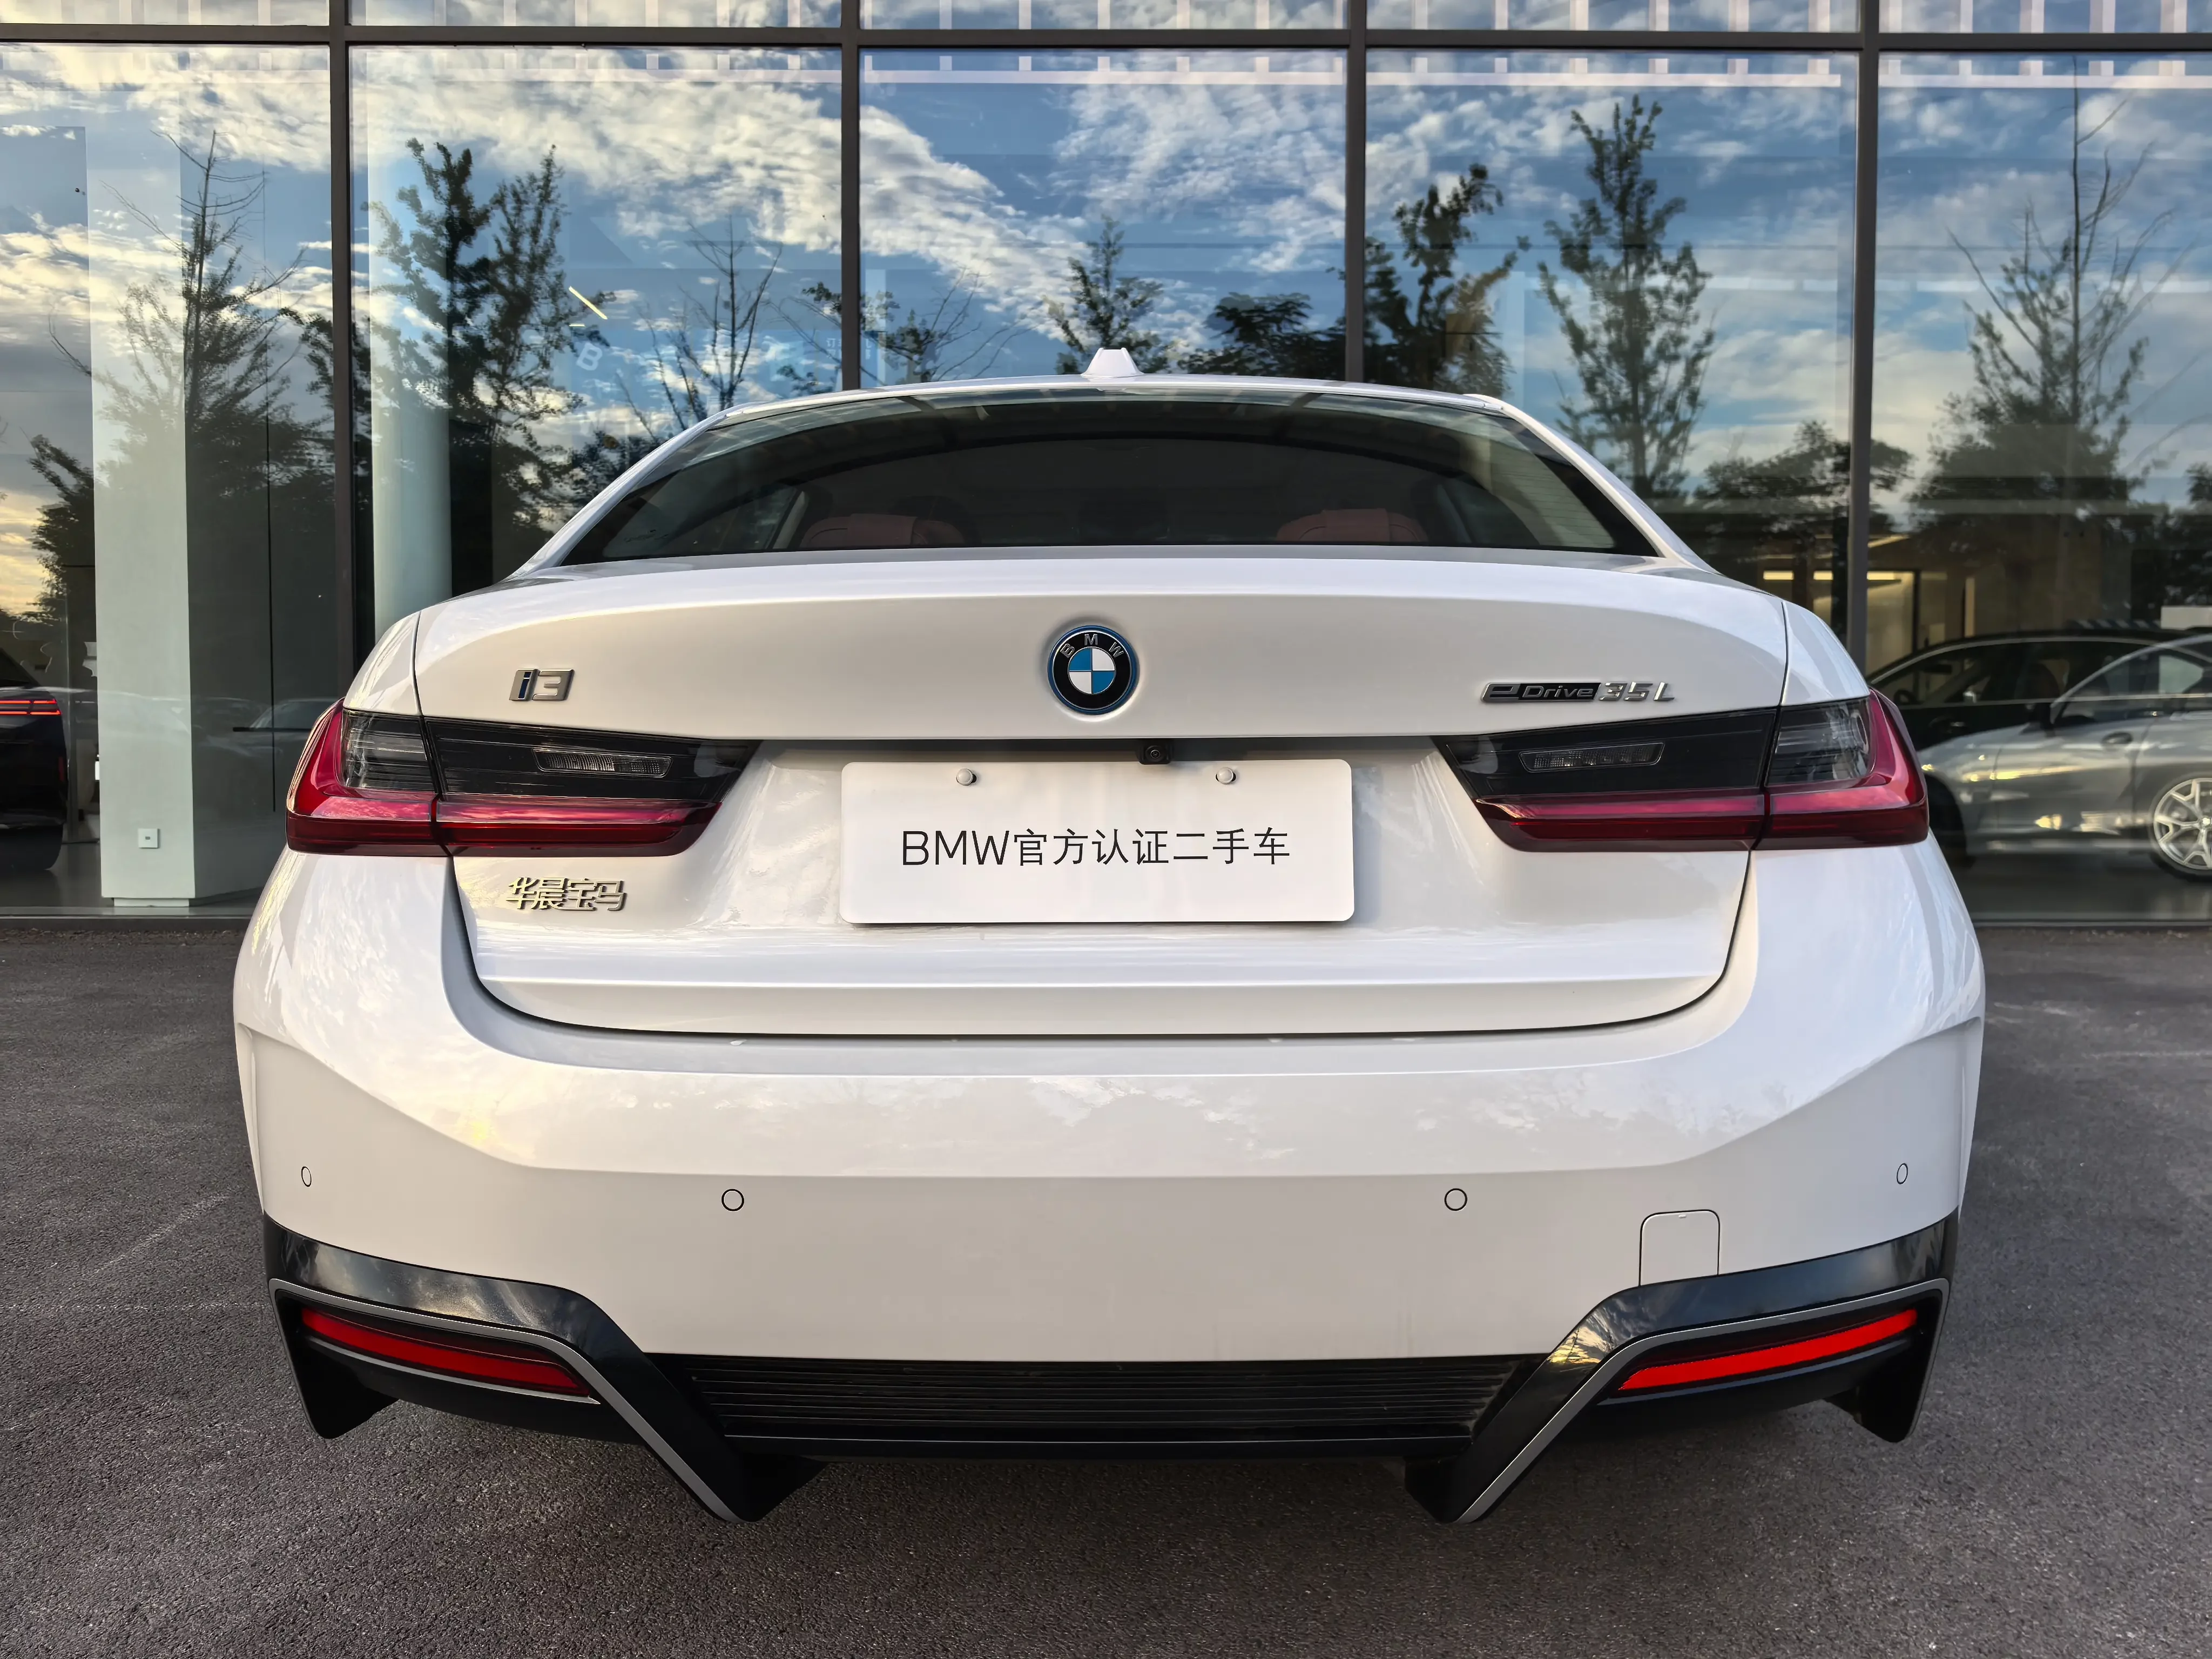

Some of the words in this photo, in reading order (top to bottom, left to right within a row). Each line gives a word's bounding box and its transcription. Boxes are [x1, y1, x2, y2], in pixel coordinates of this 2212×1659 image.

[1060, 633, 1124, 658] BMW
[509, 668, 575, 702] i3
[902, 827, 1291, 866] BMW官方认证二手车
[505, 876, 627, 911] 华晨宝马
